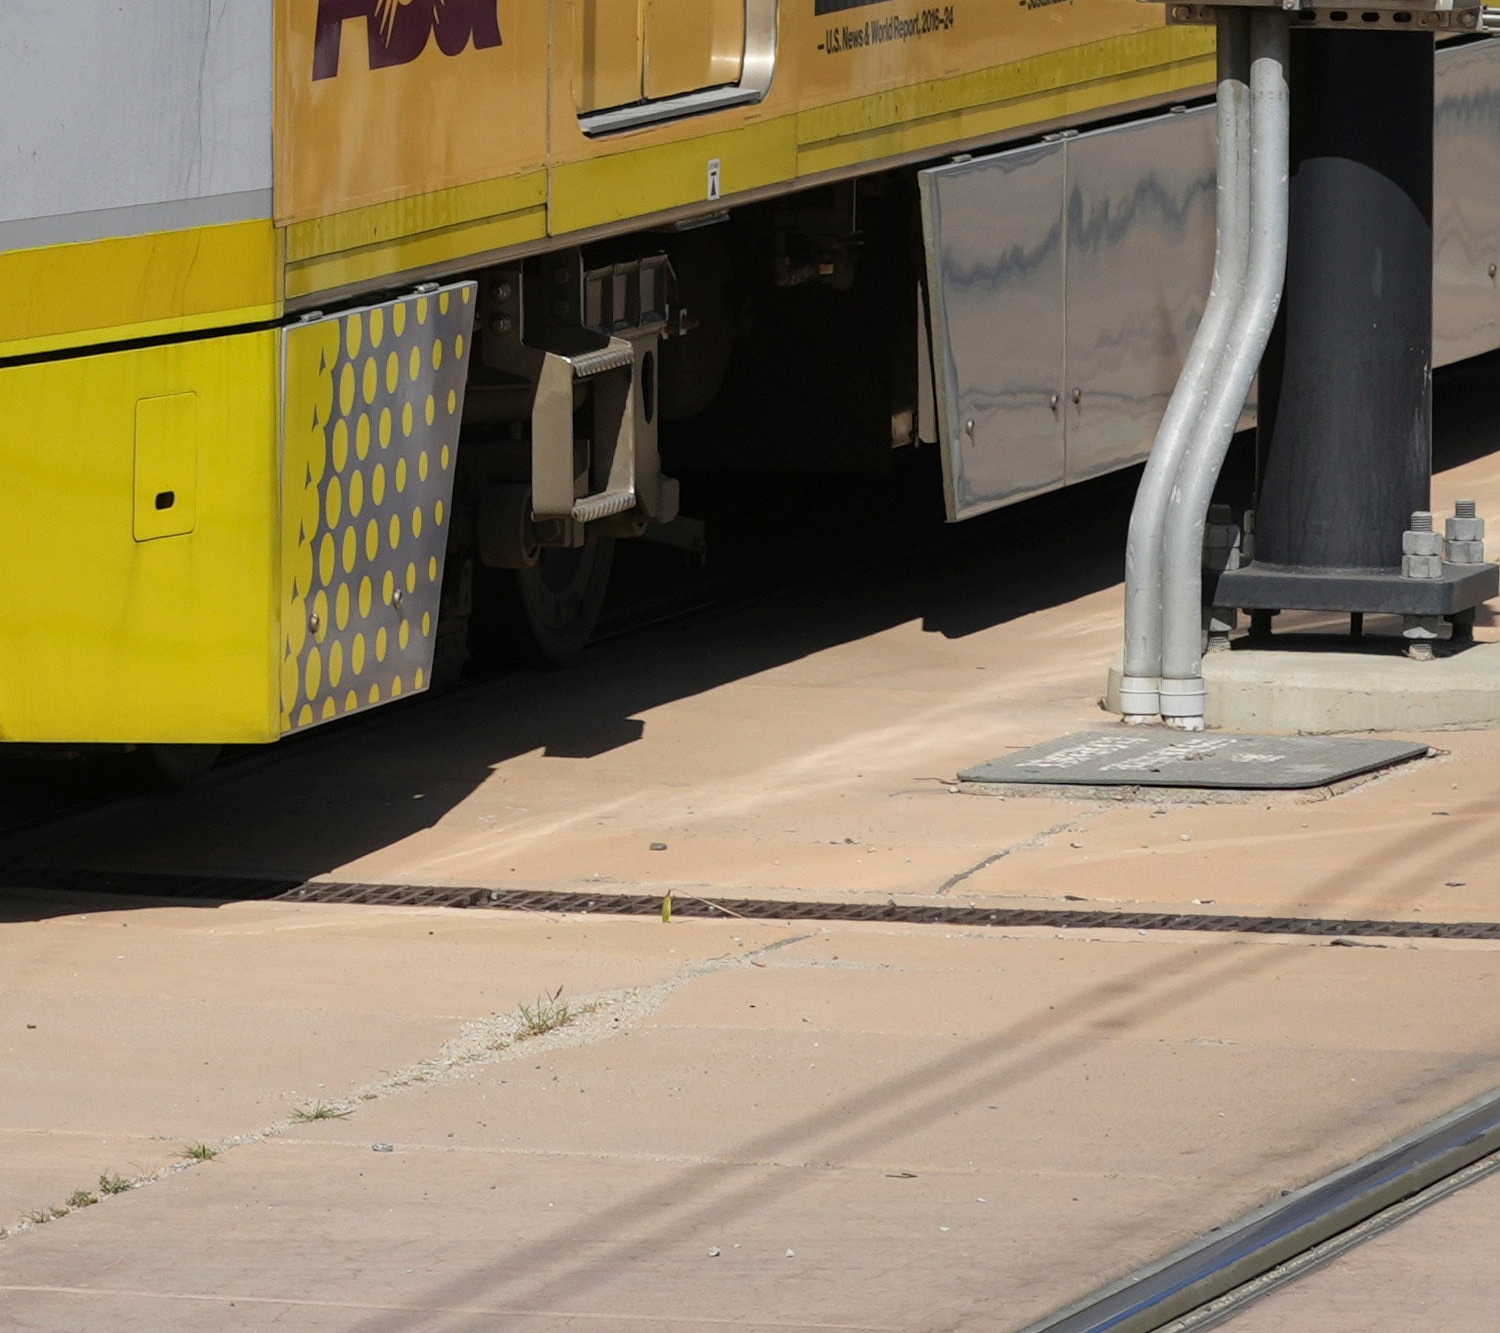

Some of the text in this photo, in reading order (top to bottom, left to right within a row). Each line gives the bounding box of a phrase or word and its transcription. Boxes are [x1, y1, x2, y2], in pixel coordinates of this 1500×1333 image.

[826, 28, 841, 54] U.S.
[842, 25, 864, 51] News
[864, 21, 870, 46] &
[871, 16, 893, 44] World
[894, 11, 921, 42] Report,
